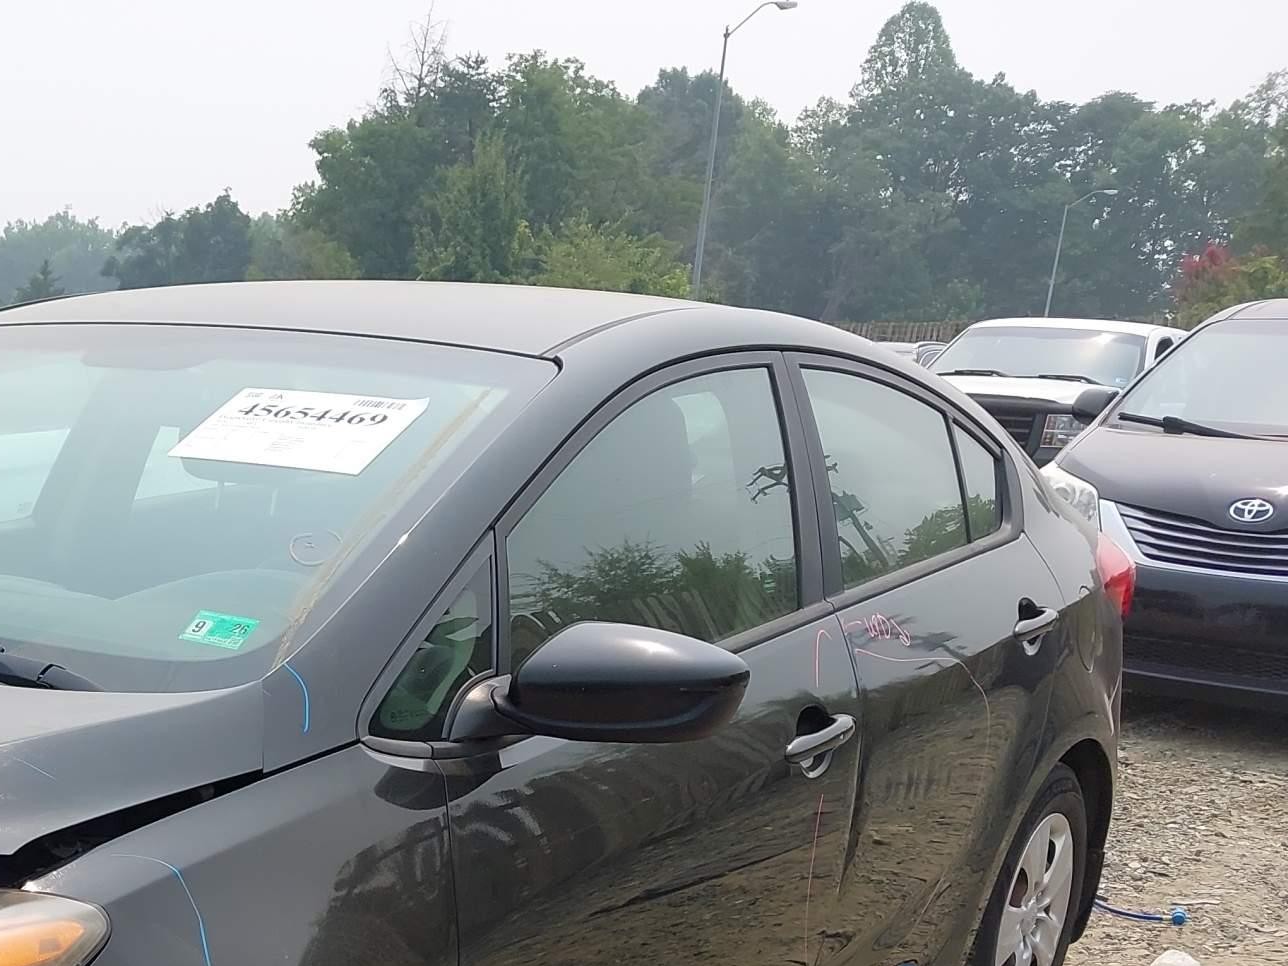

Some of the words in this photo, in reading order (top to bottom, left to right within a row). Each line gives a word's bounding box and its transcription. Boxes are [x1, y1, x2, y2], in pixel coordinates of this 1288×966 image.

[238, 402, 389, 426] 45654469
[191, 620, 207, 633] 9
[231, 623, 250, 635] 26
